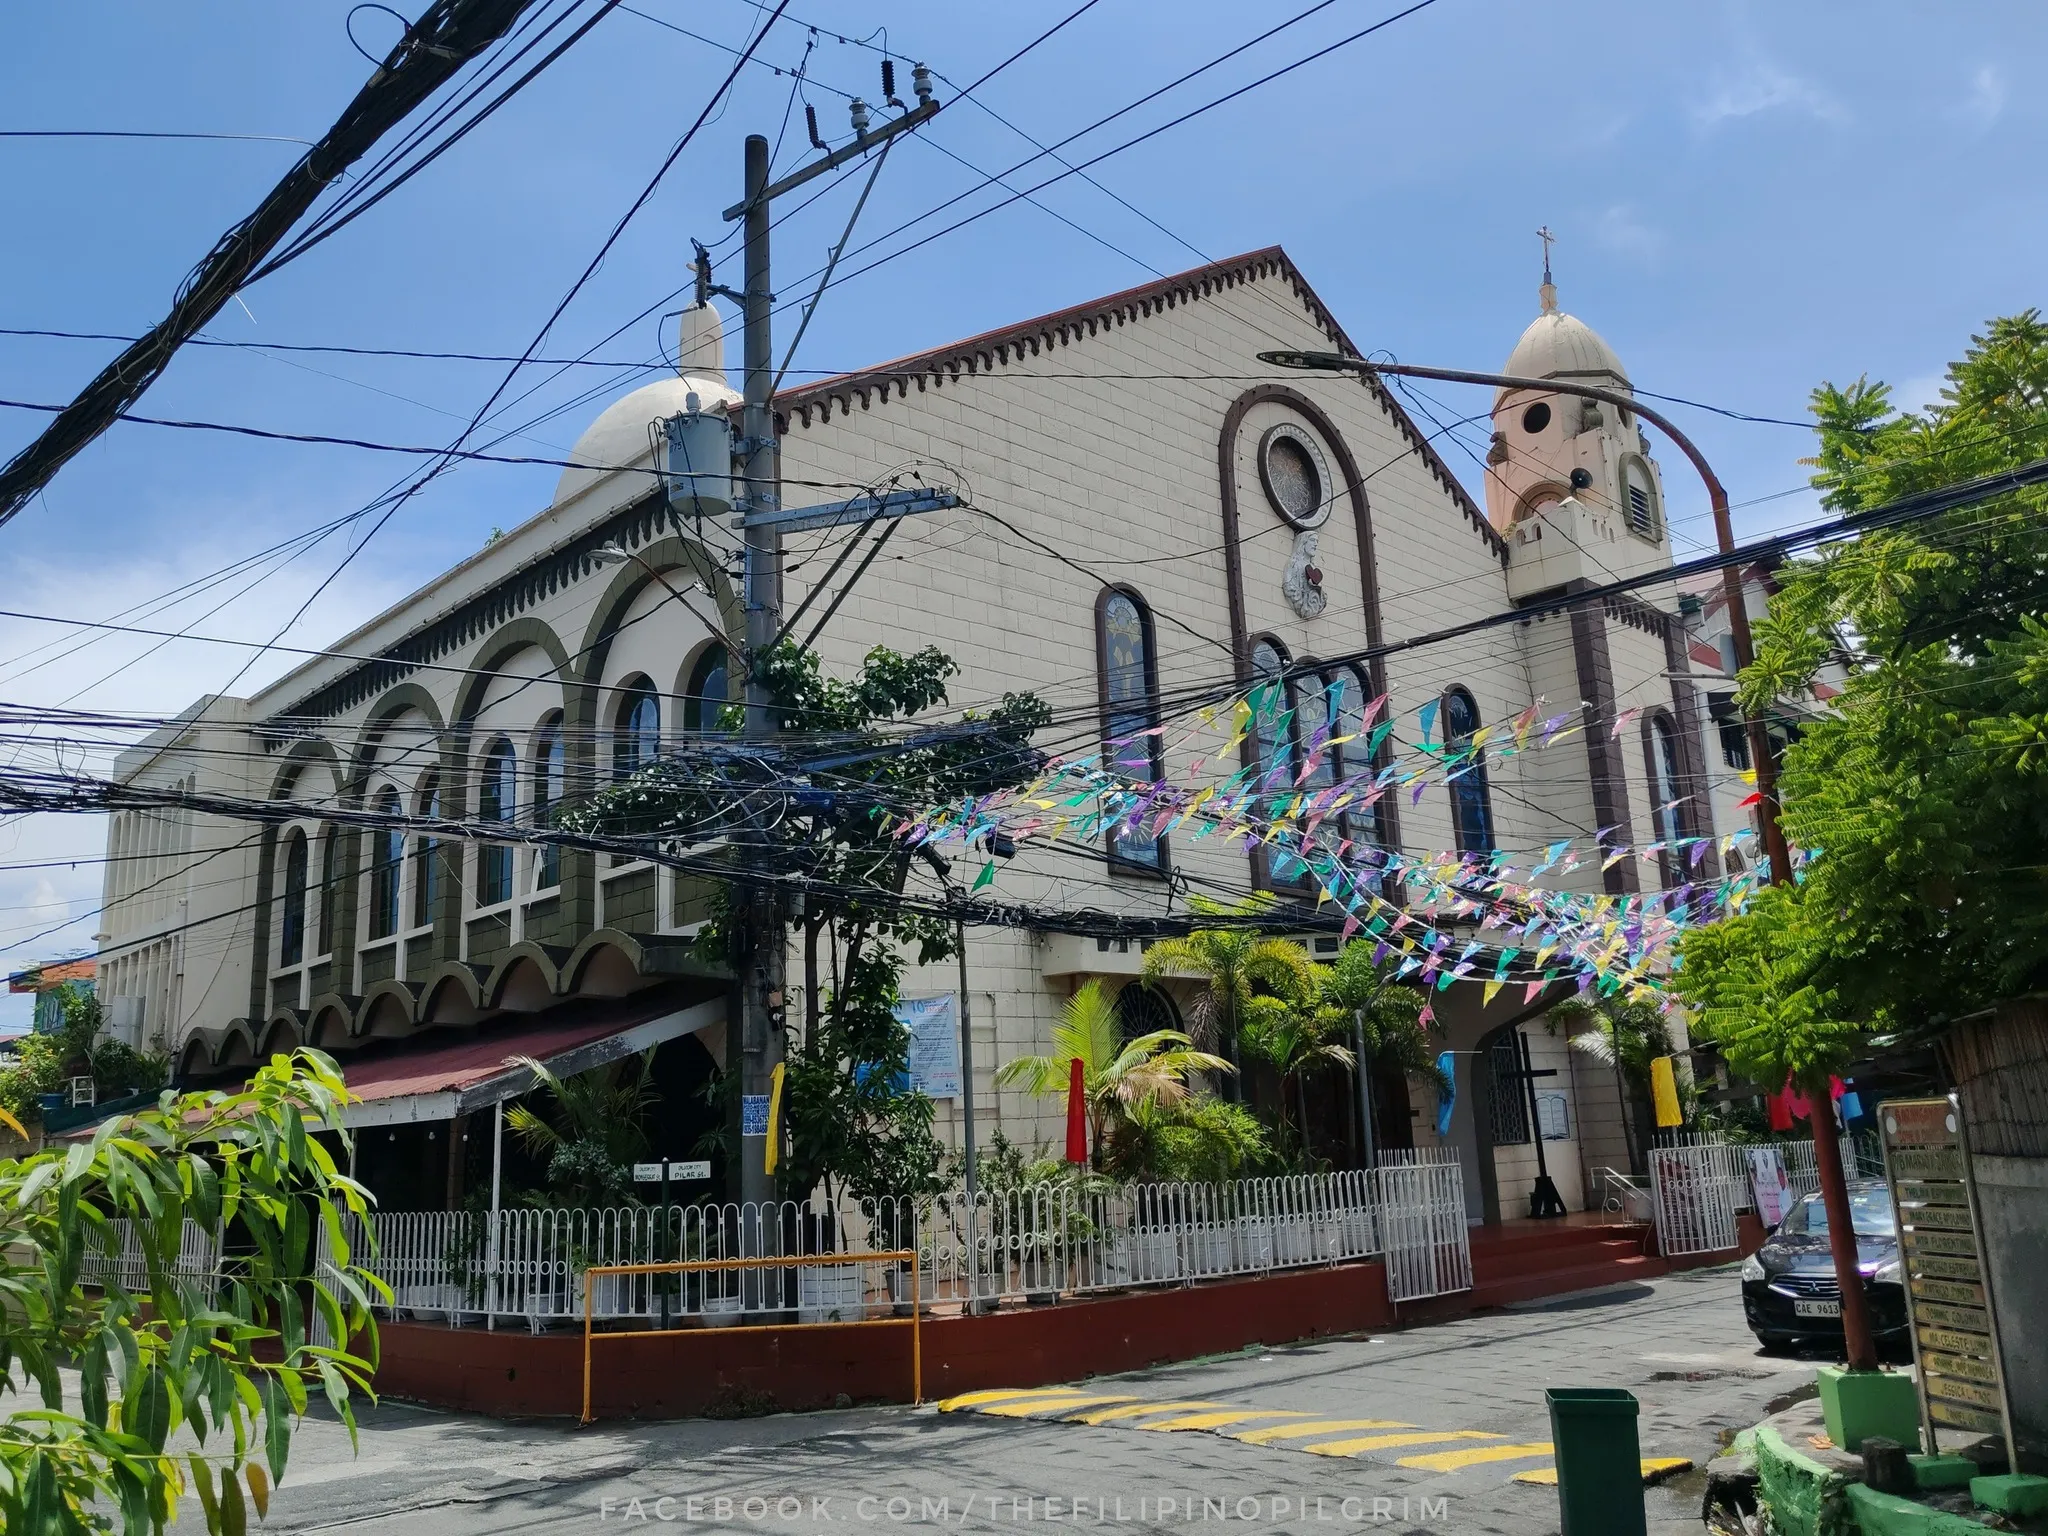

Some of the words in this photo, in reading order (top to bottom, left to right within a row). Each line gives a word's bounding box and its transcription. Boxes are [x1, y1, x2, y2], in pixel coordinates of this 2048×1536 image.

[674, 1171, 696, 1179] PILAR
[1796, 1303, 1812, 1314] CAE
[1817, 1304, 1839, 1314] 9613
[1941, 1334, 1967, 1349] CELESTE
